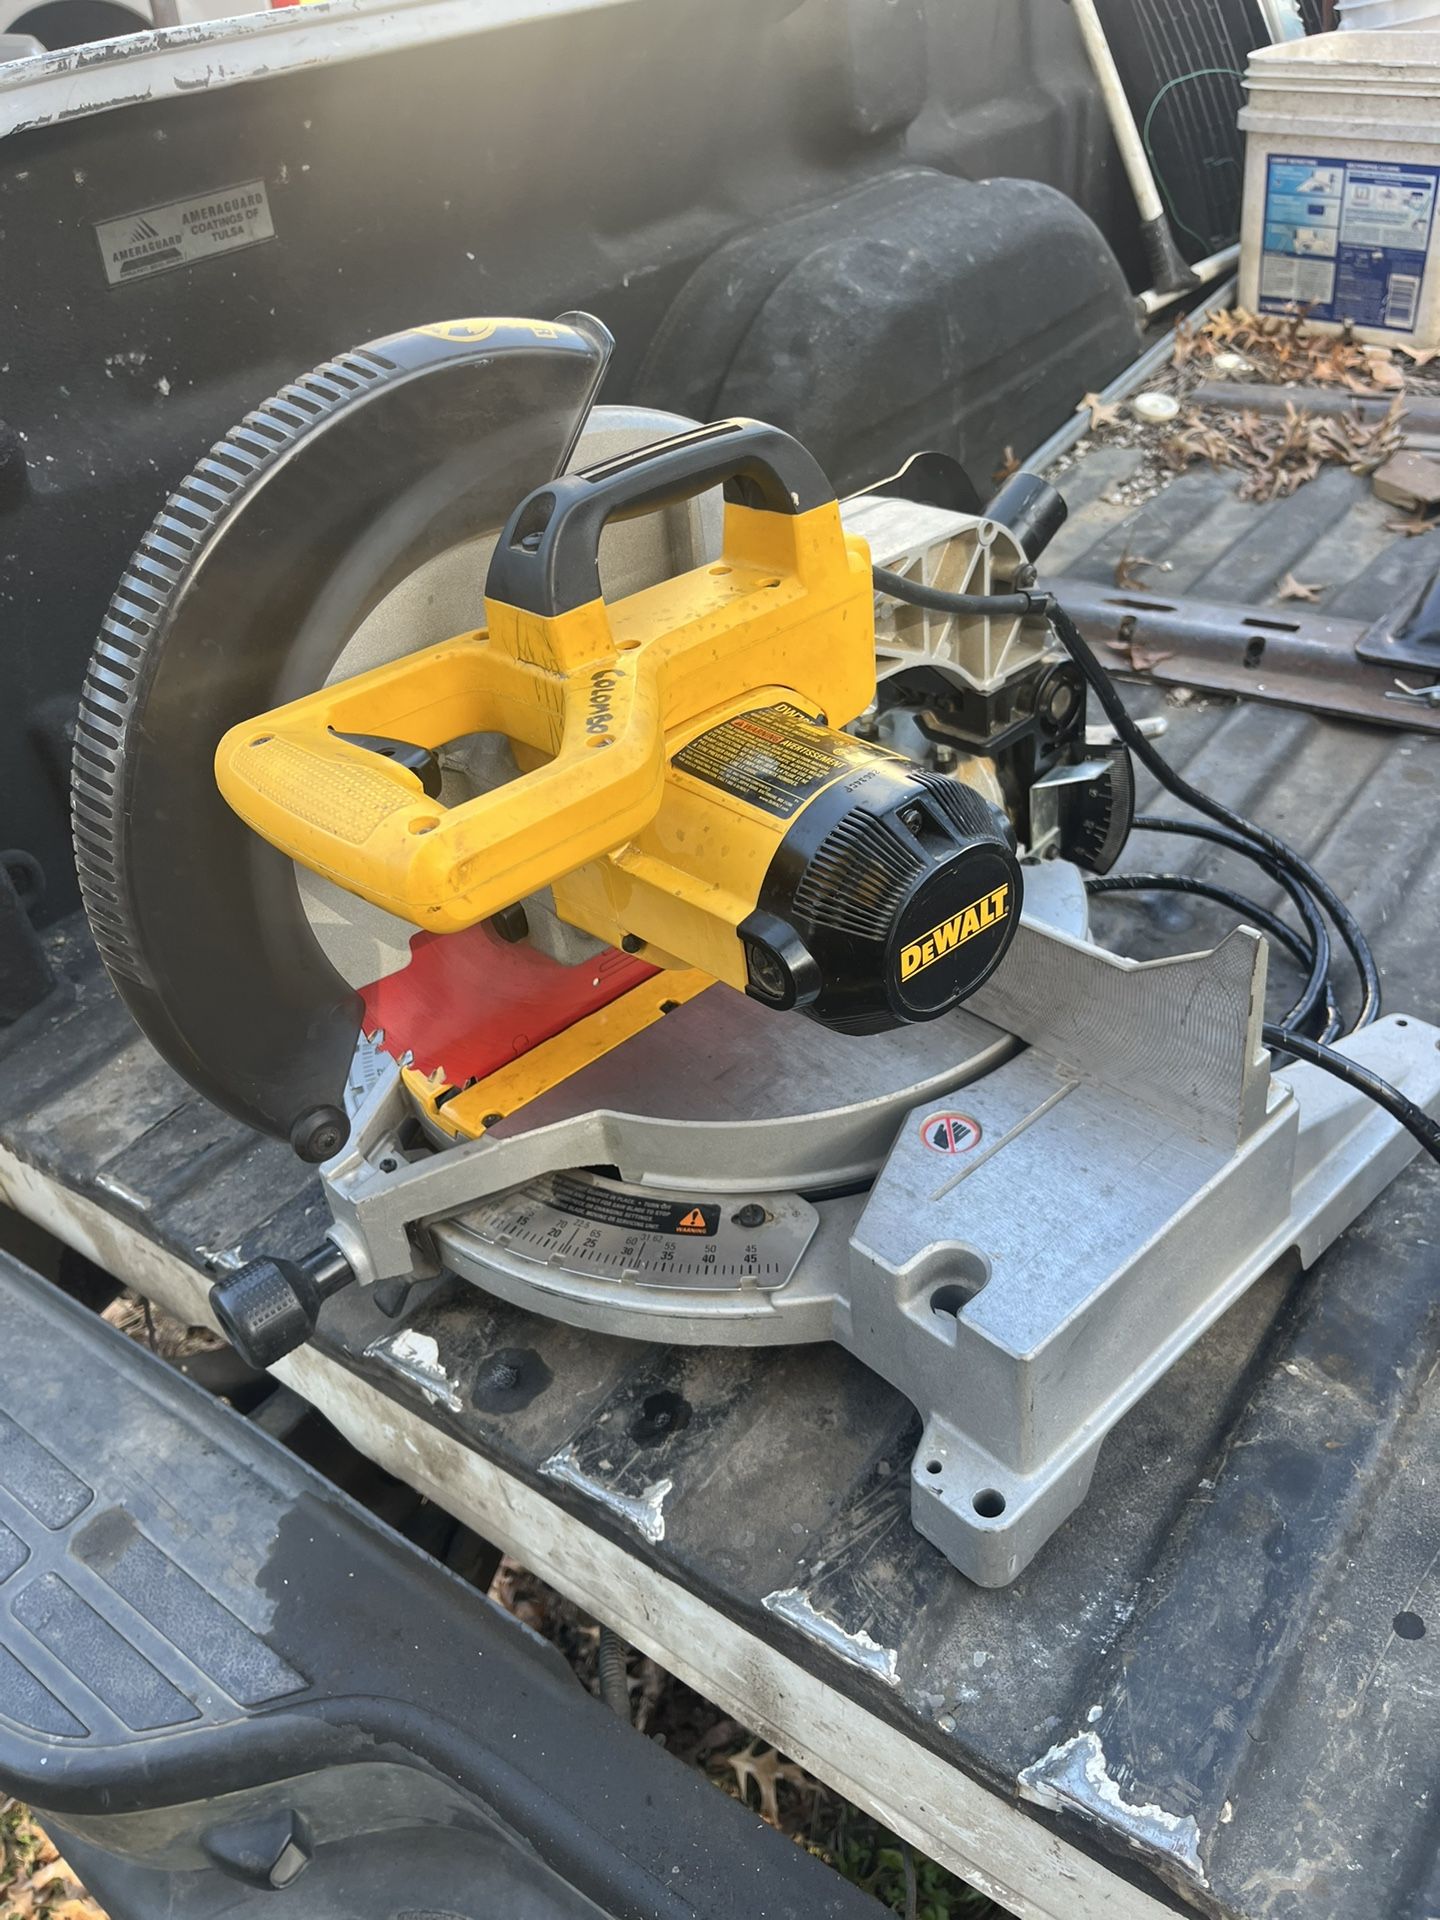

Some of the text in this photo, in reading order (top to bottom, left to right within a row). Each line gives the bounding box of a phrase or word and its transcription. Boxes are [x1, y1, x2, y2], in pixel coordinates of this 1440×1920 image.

[182, 193, 263, 225] AMERAGUARD
[191, 208, 259, 235] COATINGS OF
[212, 226, 245, 242] TULSA
[113, 235, 182, 263] AMERAGUARD
[741, 722, 784, 743] WARNING
[779, 738, 847, 769] AVERTISSEMENT
[516, 1215, 528, 1225] 15
[556, 1219, 567, 1228] 70
[547, 1228, 562, 1238] 20
[590, 1229, 601, 1238] 65
[676, 1226, 707, 1234] WARNING
[583, 1238, 598, 1248] 25
[625, 1237, 638, 1245] 60
[621, 1246, 633, 1256] 30
[664, 1242, 676, 1251] 55
[704, 1244, 717, 1253] 50
[745, 1245, 757, 1253] 45
[661, 1251, 674, 1260] 35
[702, 1254, 715, 1263] 40
[744, 1254, 757, 1263] 45
